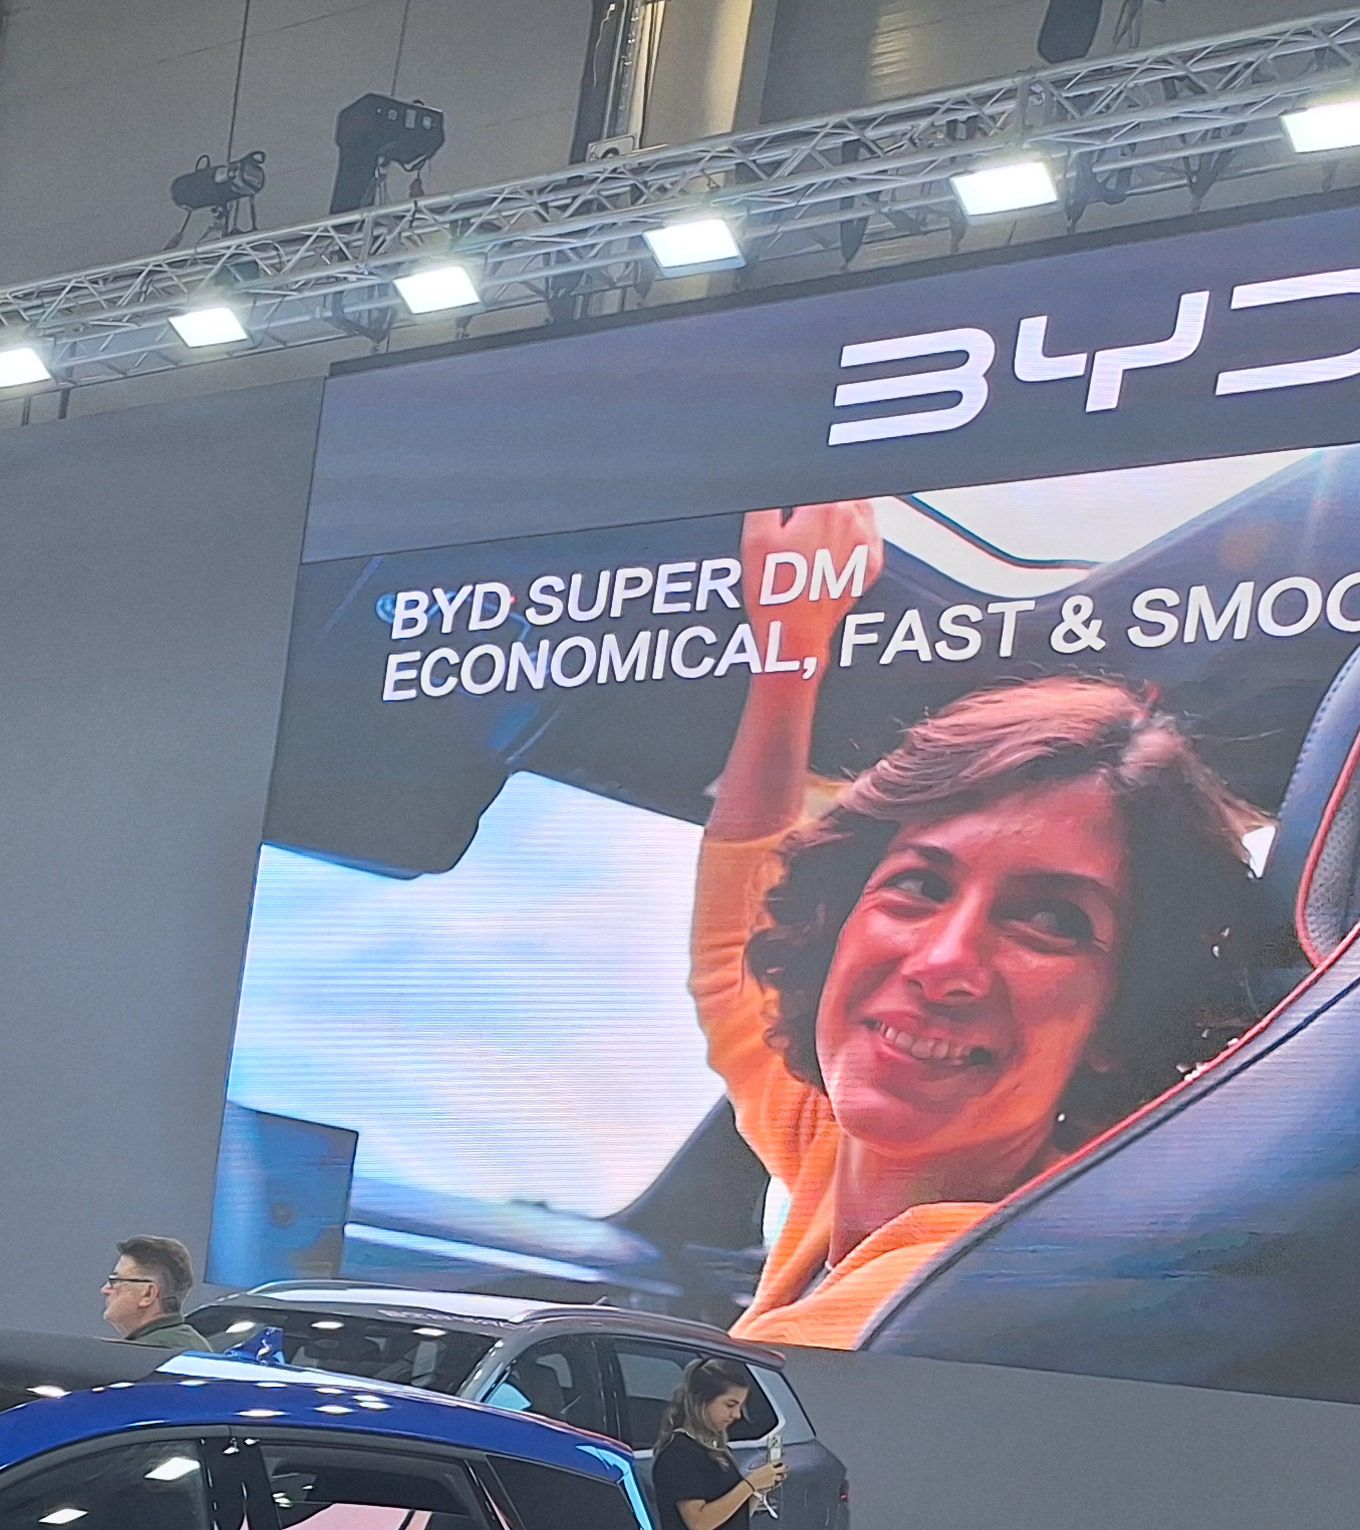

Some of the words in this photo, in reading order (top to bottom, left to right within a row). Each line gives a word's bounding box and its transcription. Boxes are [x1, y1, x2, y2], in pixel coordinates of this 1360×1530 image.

[828, 268, 1360, 446] BYD
[391, 582, 511, 640] BYD
[525, 558, 741, 626] SUPER
[759, 544, 868, 606] DM
[382, 620, 817, 702] ECONOMICAL,
[840, 600, 1036, 668] FAST
[1049, 595, 1107, 654] &
